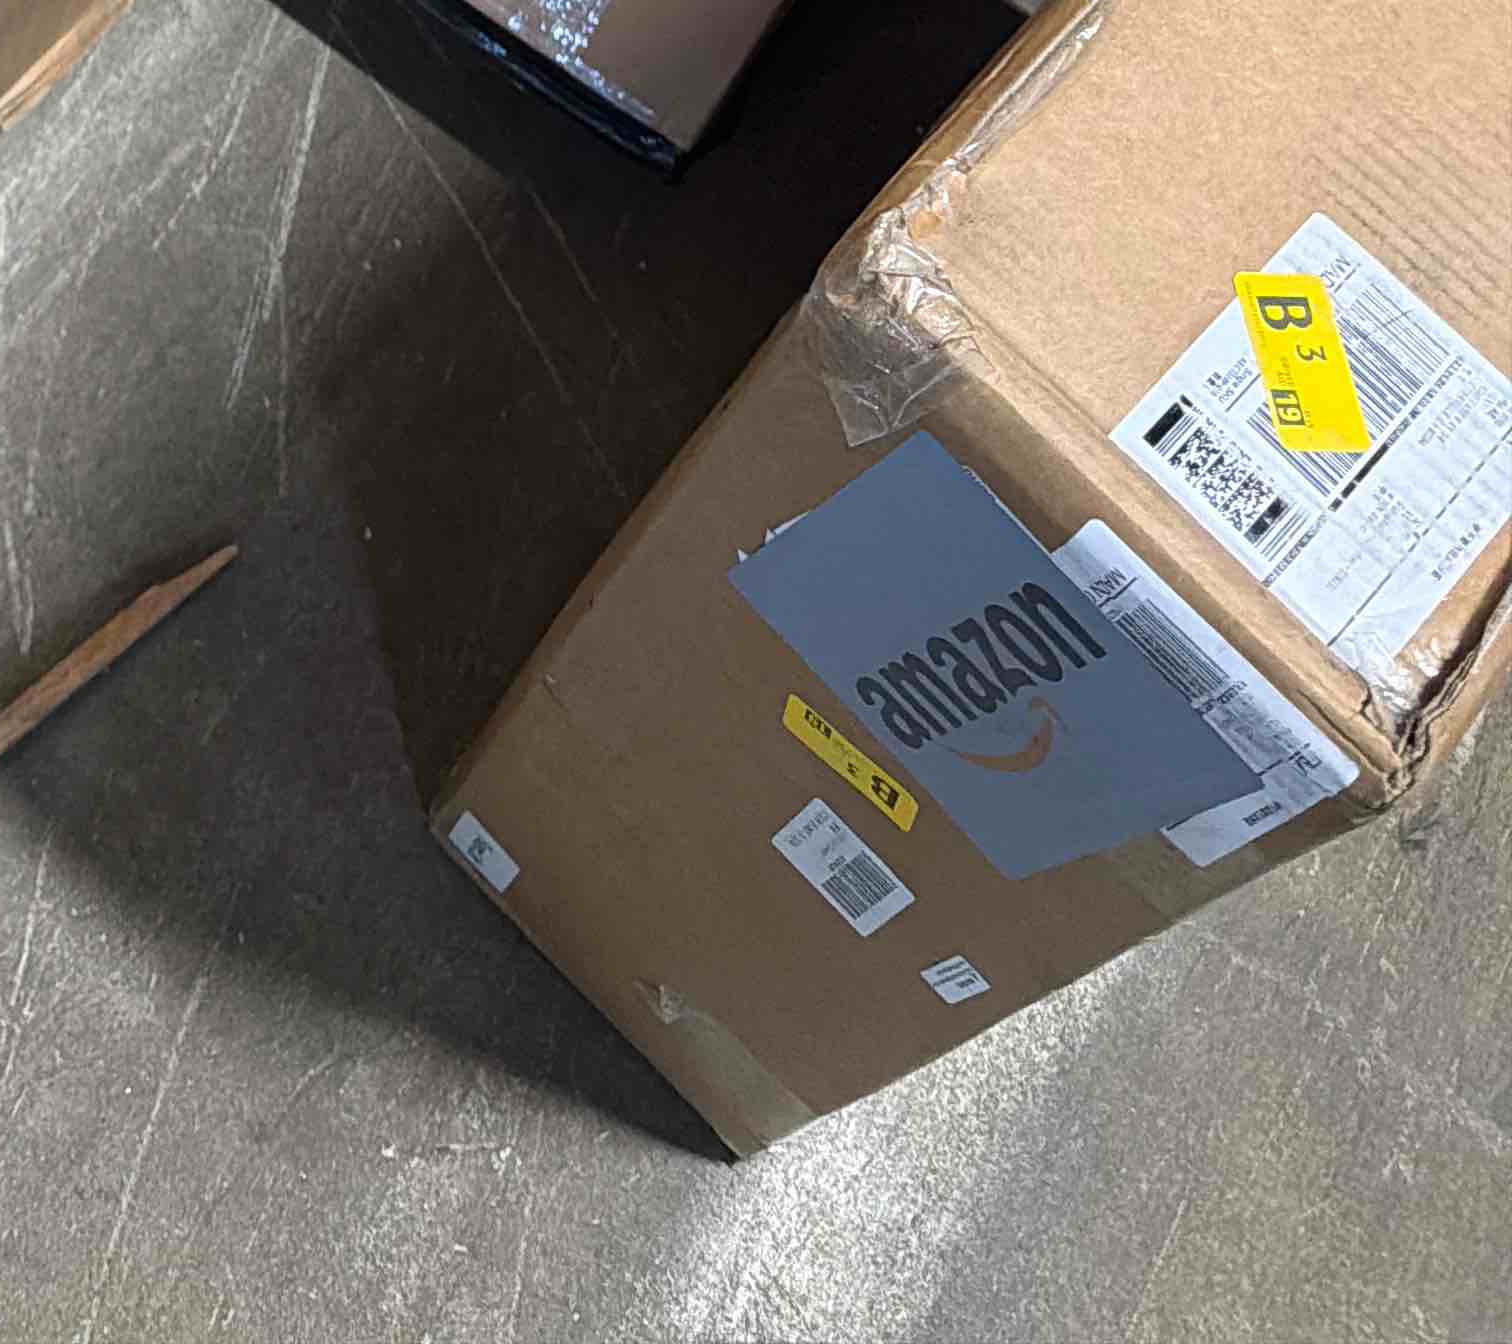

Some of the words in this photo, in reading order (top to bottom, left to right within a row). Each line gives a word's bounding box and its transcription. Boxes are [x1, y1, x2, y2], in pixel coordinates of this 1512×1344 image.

[1257, 295, 1313, 331] B
[1296, 344, 1328, 363] 3
[1273, 391, 1302, 424] 19
[855, 581, 1106, 750] amazon
